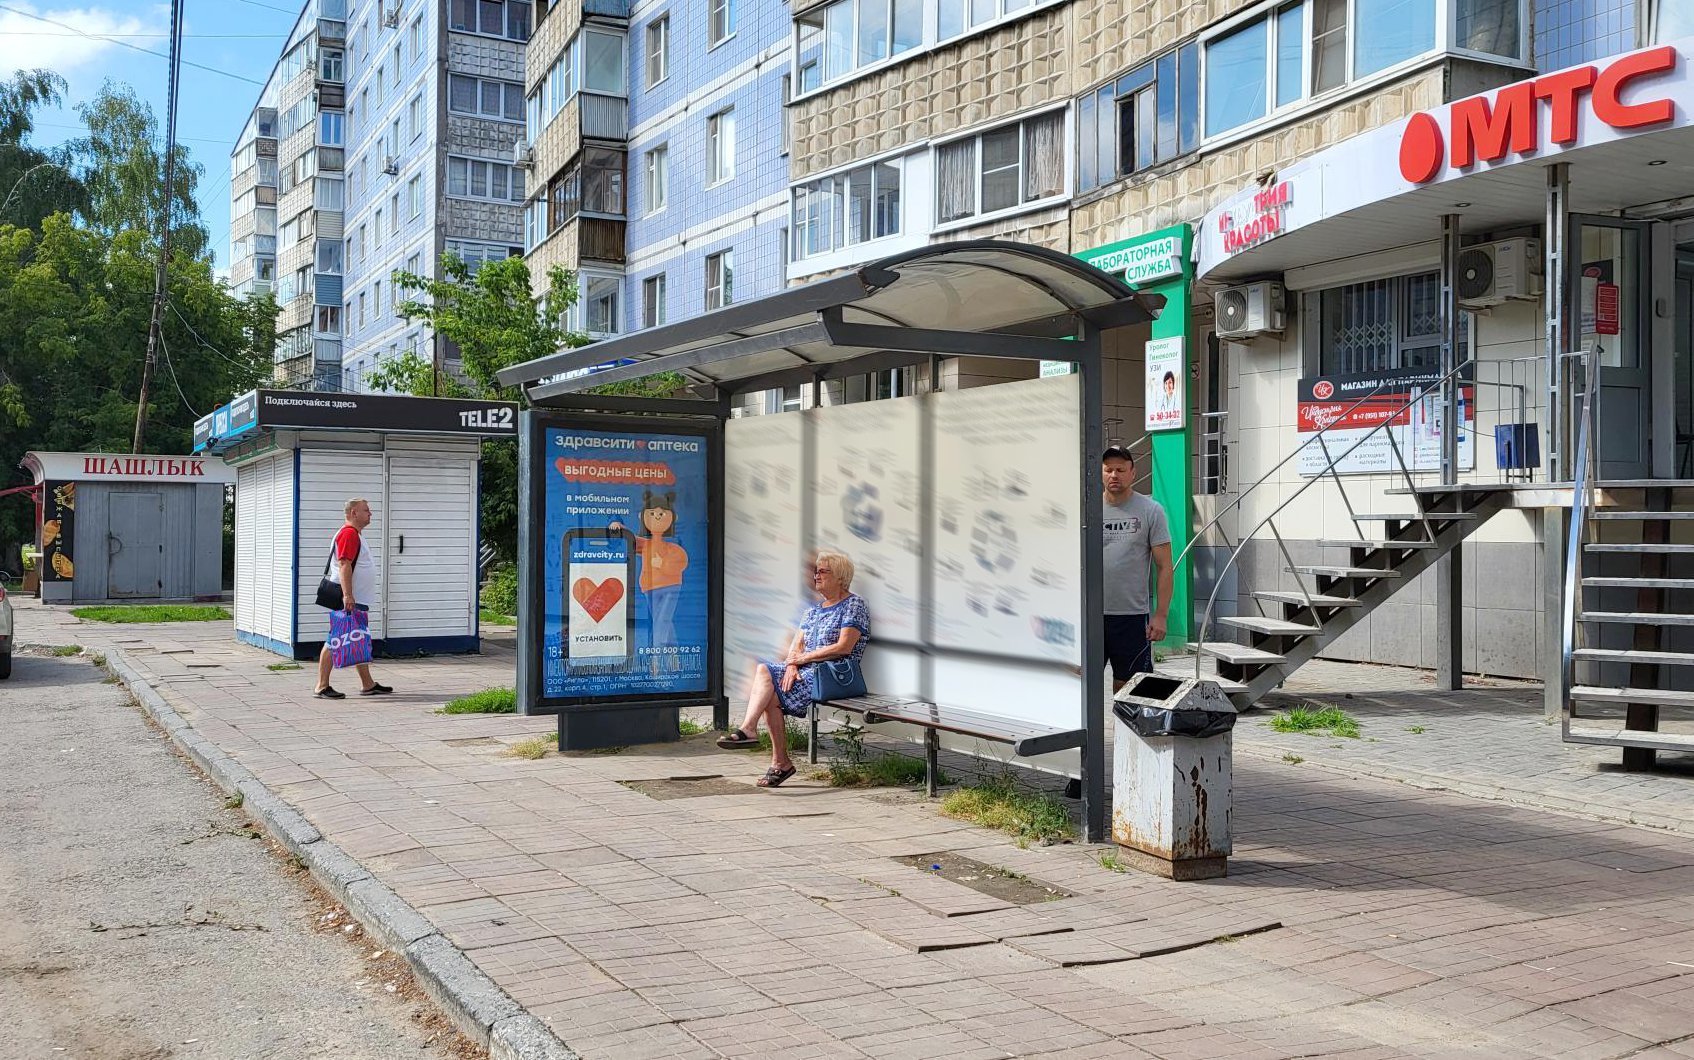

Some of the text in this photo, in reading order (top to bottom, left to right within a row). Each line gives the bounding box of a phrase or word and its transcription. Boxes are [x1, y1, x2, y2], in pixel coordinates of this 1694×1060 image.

[1451, 45, 1676, 169] МТС
[1224, 210, 1280, 254] КРАСОТЫ
[1127, 258, 1172, 281] СЛУЖБА
[1149, 364, 1161, 372] УЗИ
[1341, 379, 1378, 391] МАГАЗИН
[265, 396, 357, 409] Подключайся здесь
[459, 407, 513, 428] TELE2
[555, 435, 699, 452] здравсити аптека
[83, 457, 205, 476] ШАШЛЫК
[564, 465, 667, 479] ВЫГОДНЫЕ ЦЕНЫ
[574, 493, 630, 503] мобильном
[566, 506, 630, 515] приложении
[573, 550, 624, 560] zdravcity.ru
[575, 635, 622, 643] УСТАНОВИТЬ
[548, 646, 563, 658] 18+
